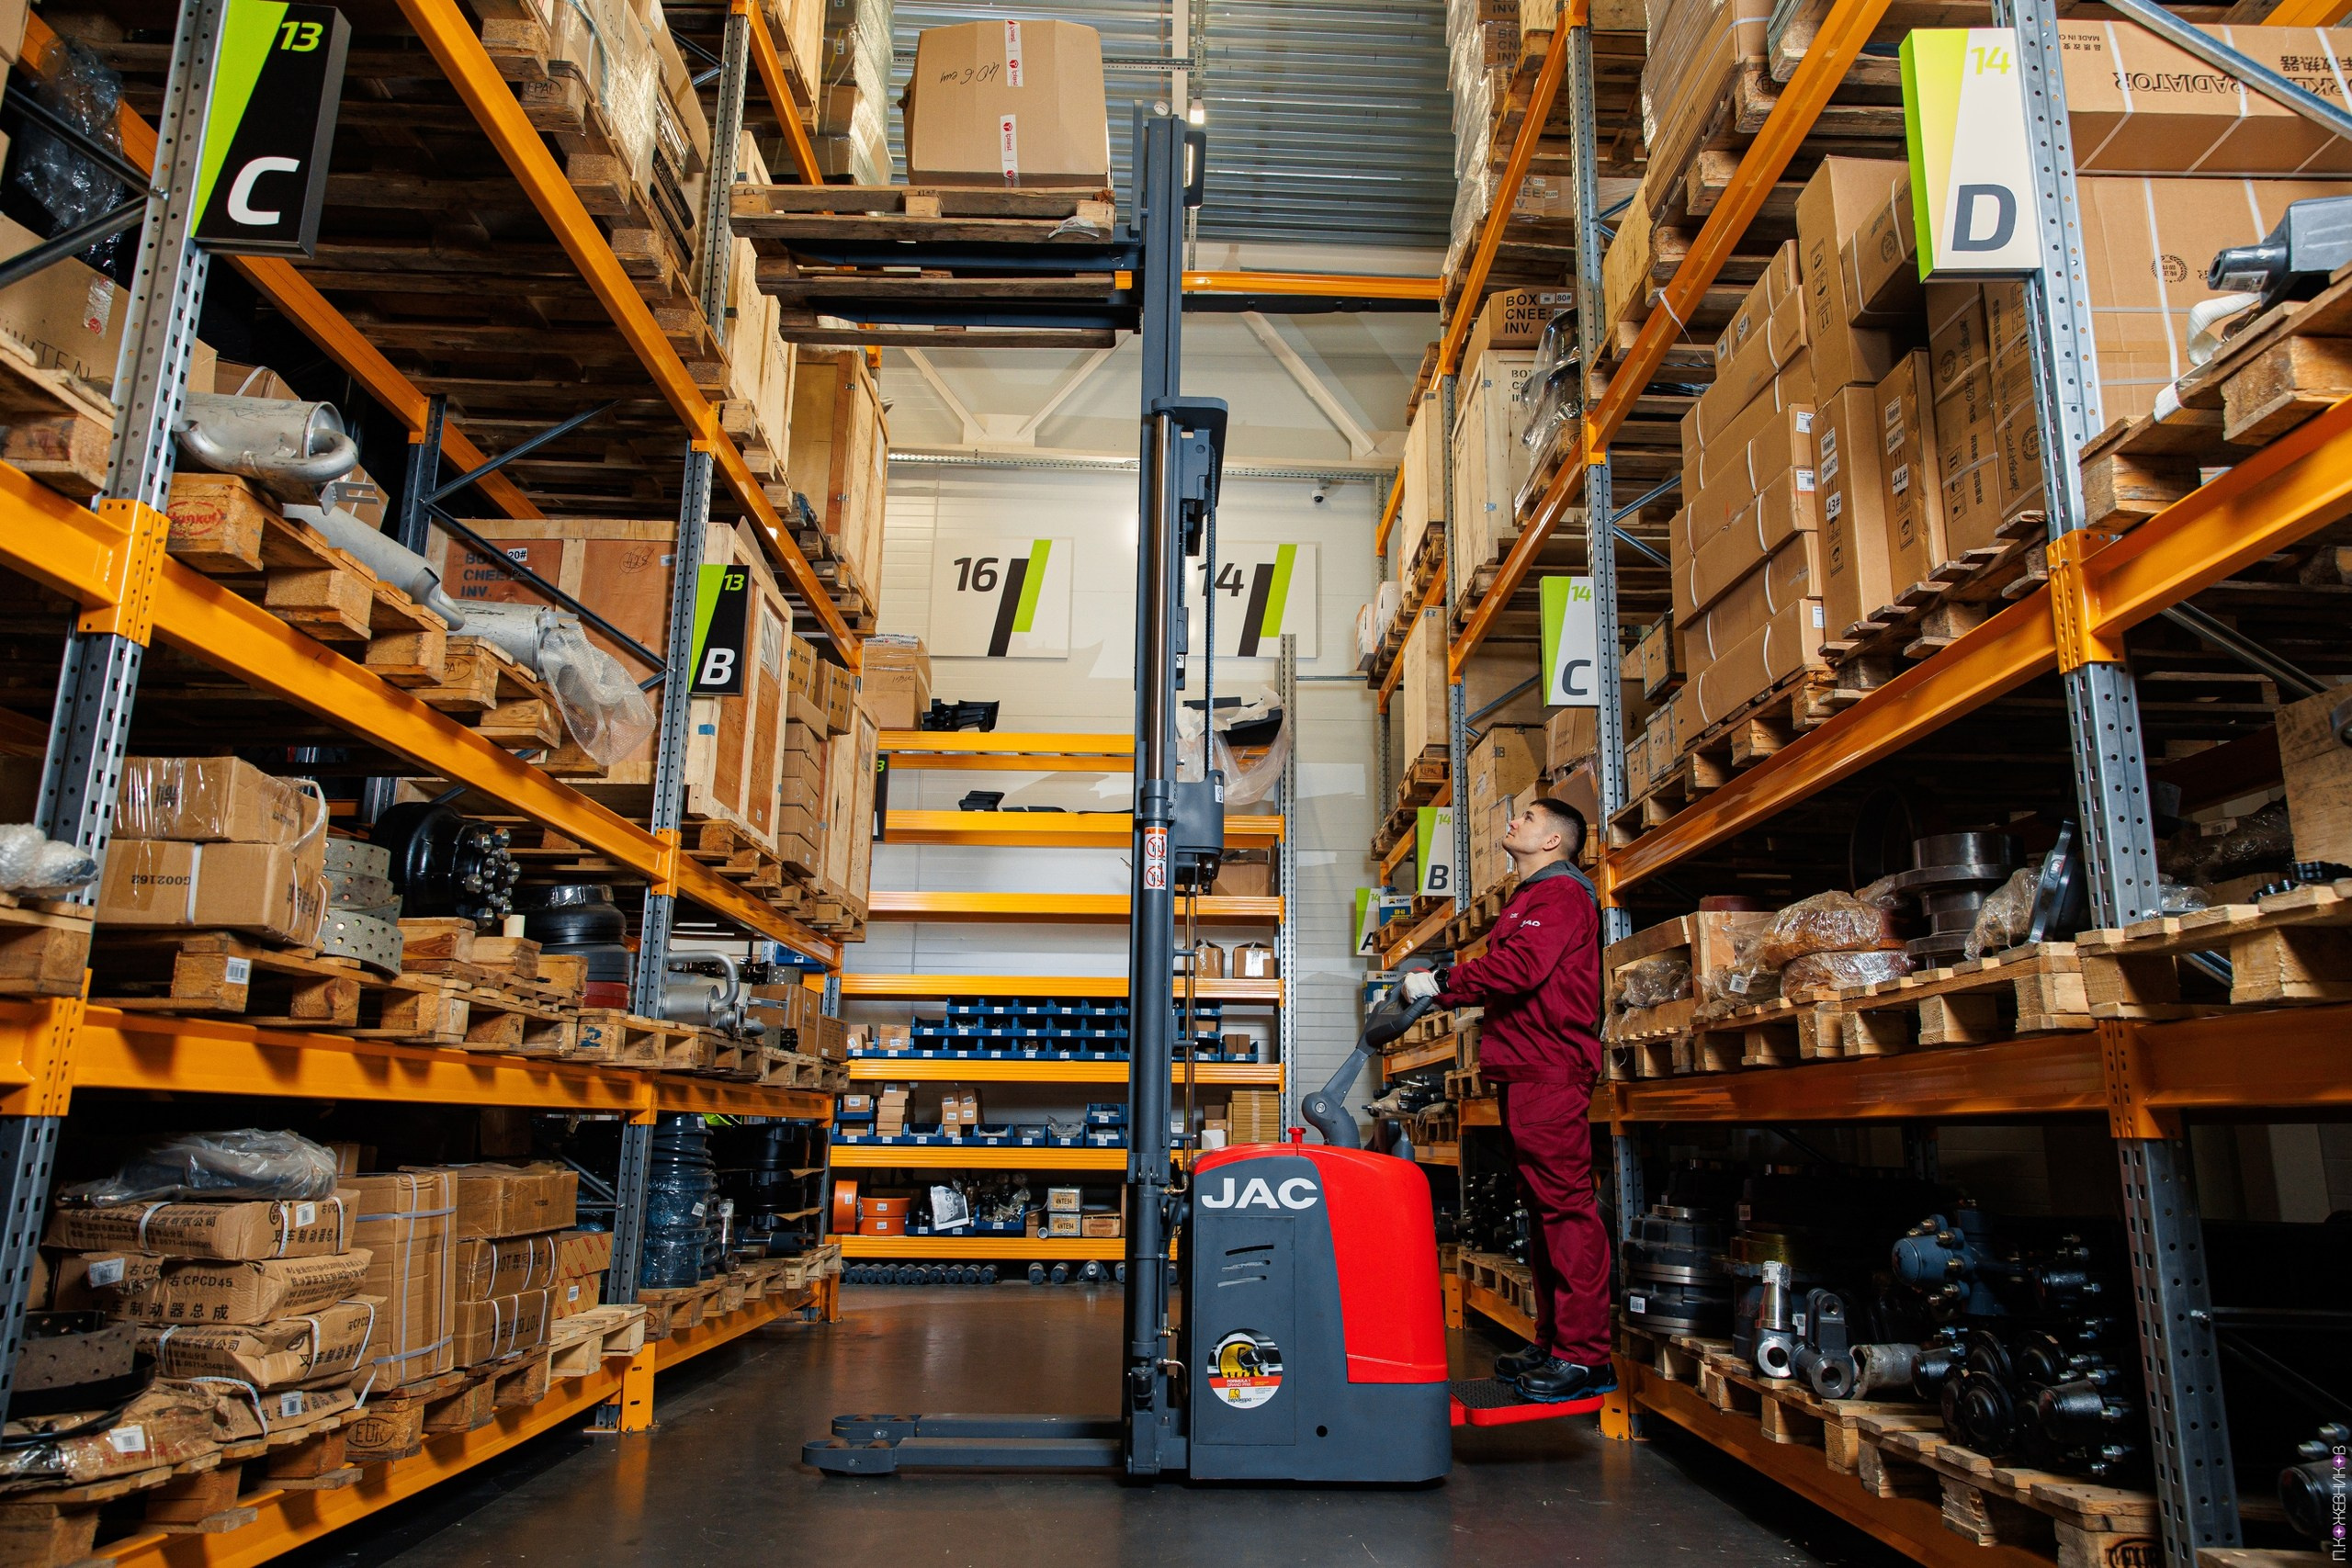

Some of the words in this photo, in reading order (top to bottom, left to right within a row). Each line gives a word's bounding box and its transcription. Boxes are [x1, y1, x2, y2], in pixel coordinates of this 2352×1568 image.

[279, 21, 323, 52] 13
[1498, 29, 1520, 38] BO
[1970, 46, 2011, 75] 14
[227, 156, 300, 225] C
[1951, 184, 2017, 253] D
[1506, 294, 1538, 307] BOX
[1505, 309, 1552, 320] CNEE:
[1505, 322, 1533, 333] INV.
[1893, 470, 1907, 488] 44#
[1826, 498, 1840, 513] 43#
[508, 550, 526, 559] 20#
[723, 574, 744, 592] 13
[953, 557, 998, 592] 16
[1197, 563, 1244, 597] 14
[1570, 586, 1591, 602] 14
[699, 648, 737, 686] B
[1561, 659, 1591, 695] C
[1437, 813, 1452, 825] 14
[1428, 865, 1449, 890] B
[1201, 1178, 1318, 1210] JAC
